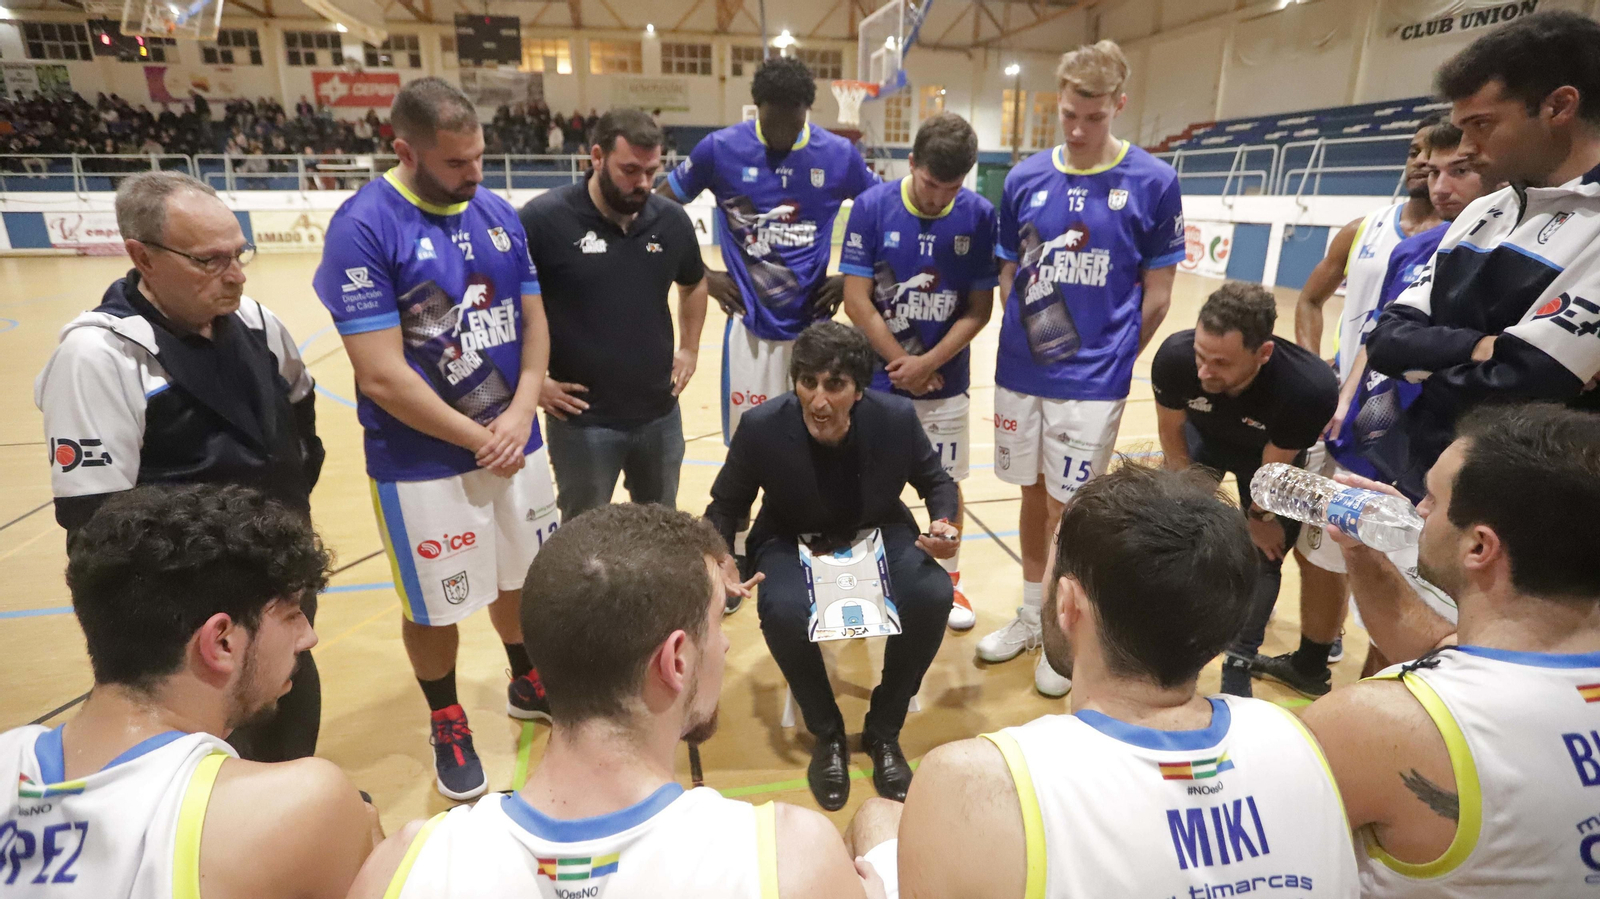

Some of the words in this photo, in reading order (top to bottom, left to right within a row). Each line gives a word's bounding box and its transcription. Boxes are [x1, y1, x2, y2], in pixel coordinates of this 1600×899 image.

[1400, 17, 1454, 40] CLUB
[1460, 0, 1539, 29] UNION
[781, 175, 788, 188] 1
[1069, 197, 1086, 212] 15
[257, 232, 302, 243] AMADO
[920, 242, 933, 256] 11
[1053, 250, 1110, 270] ENER
[1038, 265, 1109, 287] DRINK
[908, 291, 957, 307] ENER
[745, 390, 767, 405] ice
[1000, 415, 1018, 431] ice
[936, 442, 957, 461] 11
[1063, 455, 1092, 482] 15
[443, 531, 476, 553] ice
[1166, 795, 1271, 870] MIKI
